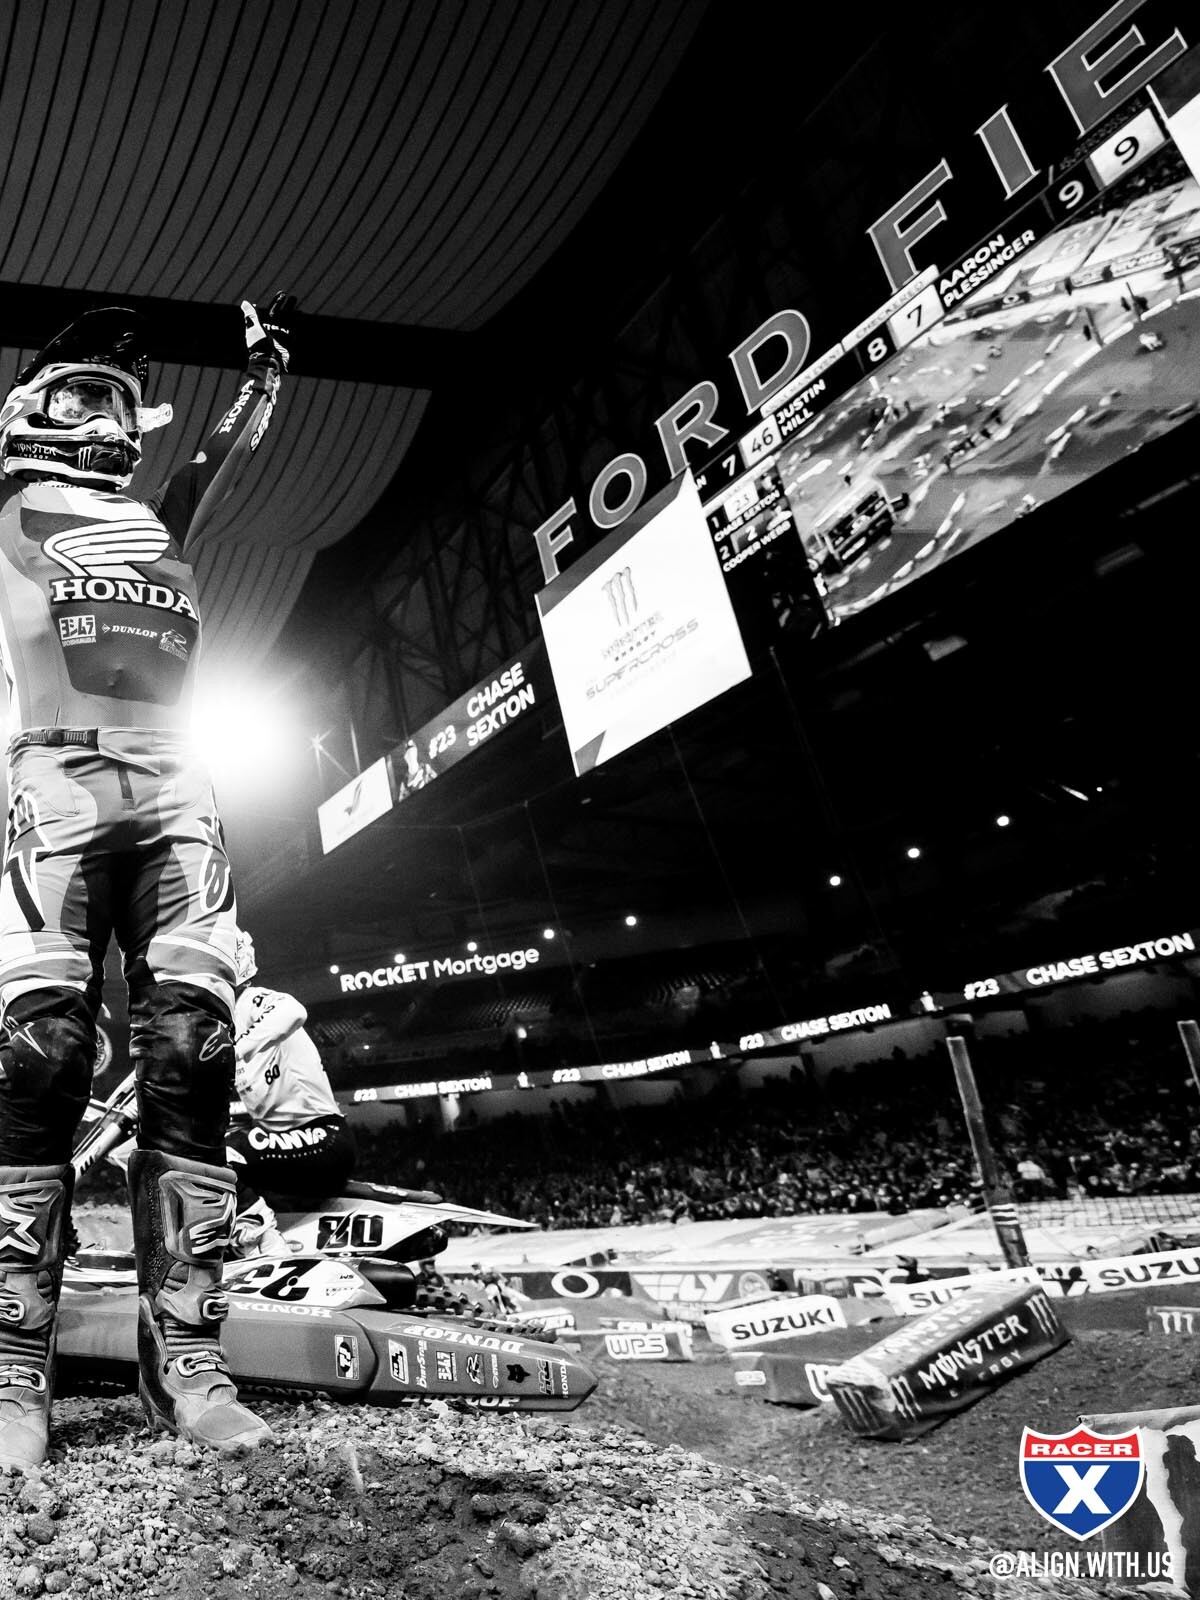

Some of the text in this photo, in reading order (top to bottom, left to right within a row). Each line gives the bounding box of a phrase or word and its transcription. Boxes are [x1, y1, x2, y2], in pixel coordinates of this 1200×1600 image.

[1114, 136, 1140, 165] 9
[1058, 180, 1084, 209] 9
[939, 234, 1005, 294] AARON
[943, 229, 1036, 307] PLESSINGER
[907, 304, 922, 328] 7
[867, 337, 887, 362] 8
[777, 379, 826, 424] JUSTIN
[781, 408, 814, 436] HILL
[534, 308, 810, 584] FORD
[752, 427, 774, 453] 46
[722, 454, 736, 476] 7
[711, 516, 720, 528] 1
[714, 490, 780, 542] CHASE SEXTON
[719, 525, 758, 560] 2 2
[723, 520, 792, 572] COOPER WEBB
[51, 578, 199, 621] HONDA
[111, 625, 158, 638] DUNLOP
[466, 662, 525, 718] CHASE
[466, 683, 536, 747] SEXTON
[428, 725, 456, 759] #23
[340, 949, 539, 992] ROCKET Mortgage
[963, 932, 1195, 1000] #23 CHASE SEXTON
[739, 1004, 891, 1051] #23 CHASE SEXTON
[264, 1064, 280, 1085] 80
[552, 1050, 691, 1083] #23 CHASE SEXTON
[354, 1078, 492, 1101] #23 CHASE SEXTON
[632, 1274, 734, 1301] FLY
[233, 1302, 332, 1318] HONDA
[731, 1307, 835, 1340] SUZUKI
[404, 1324, 524, 1353] DUNLOP
[605, 1334, 669, 1360] WPS
[917, 1315, 1028, 1390] MONSTER
[560, 1359, 568, 1398] HONDA
